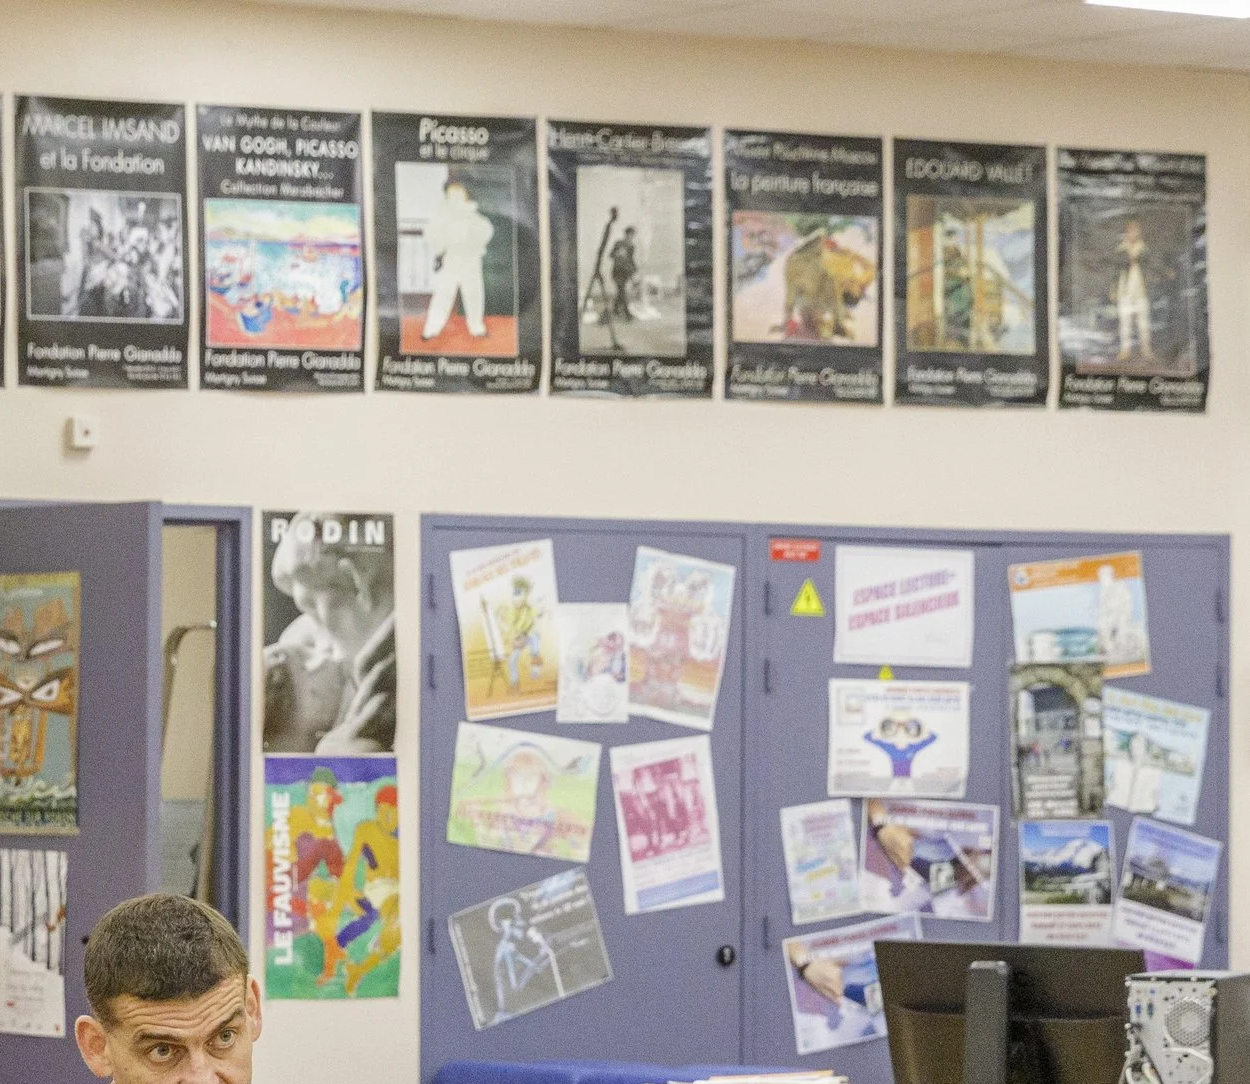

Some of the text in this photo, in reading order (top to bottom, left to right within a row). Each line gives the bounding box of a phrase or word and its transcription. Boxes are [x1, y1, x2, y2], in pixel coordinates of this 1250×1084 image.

[419, 117, 489, 145] Picasso
[202, 133, 237, 153] VAN
[295, 138, 359, 160] PICASSO
[81, 147, 165, 175] Fondation
[271, 518, 386, 545] RODIN
[272, 791, 293, 966] LE FAUVISME
